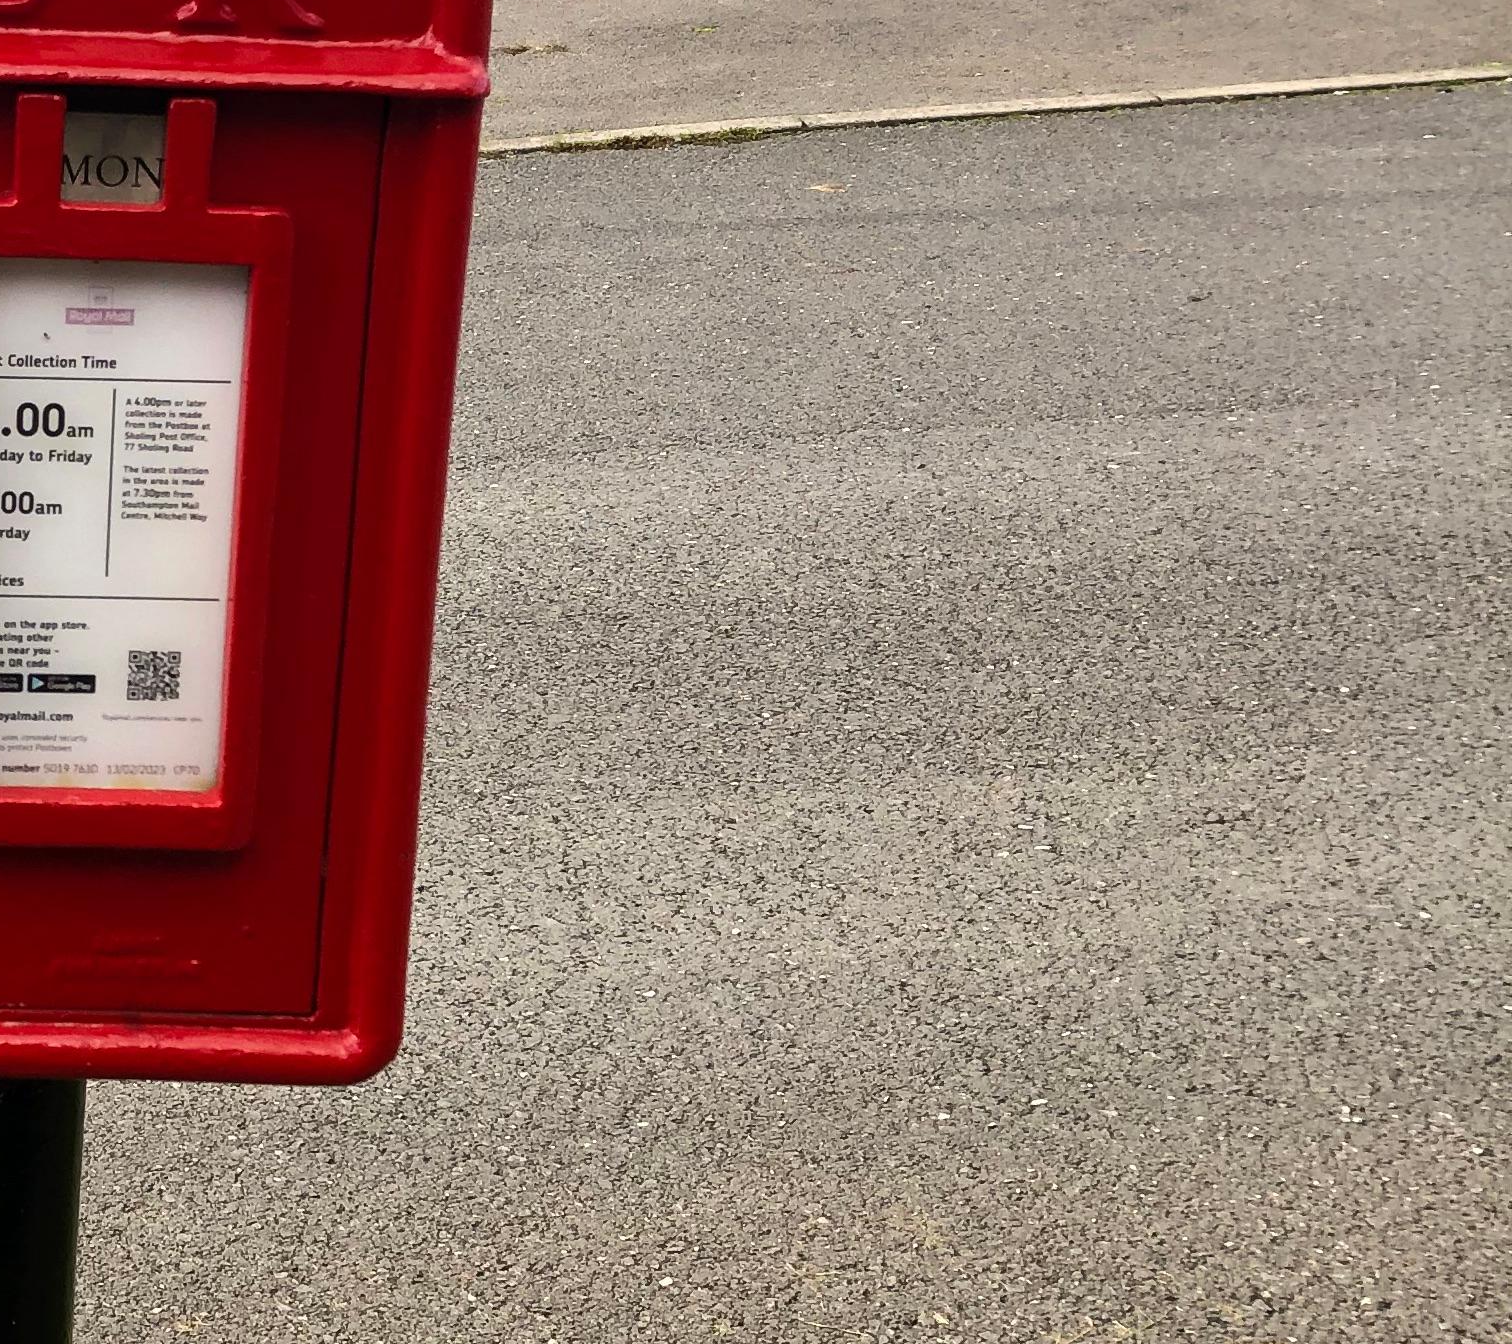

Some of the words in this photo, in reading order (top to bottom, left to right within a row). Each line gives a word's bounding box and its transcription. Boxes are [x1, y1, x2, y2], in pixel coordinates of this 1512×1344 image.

[61, 154, 165, 190] MON
[8, 354, 77, 368] Collection
[81, 355, 117, 369] Time
[134, 397, 172, 408] 4.00pm
[125, 410, 166, 418] collection
[179, 411, 202, 419] made
[125, 420, 145, 429] from
[159, 432, 178, 441] Post
[124, 442, 135, 451] 77
[172, 444, 194, 452] Road
[29, 450, 43, 462] to
[48, 449, 93, 465] Friday
[124, 465, 139, 473] The
[141, 466, 166, 474] latest
[169, 467, 209, 475] collection
[133, 477, 147, 485] the
[121, 500, 179, 509] Southampton
[20, 619, 36, 629] the
[39, 621, 58, 630] app
[61, 621, 90, 630] store.
[26, 632, 54, 642] other
[7, 646, 30, 654] near
[32, 646, 51, 656] you
[8, 658, 23, 668] QR
[26, 658, 49, 668] code
[1, 763, 40, 773] number
